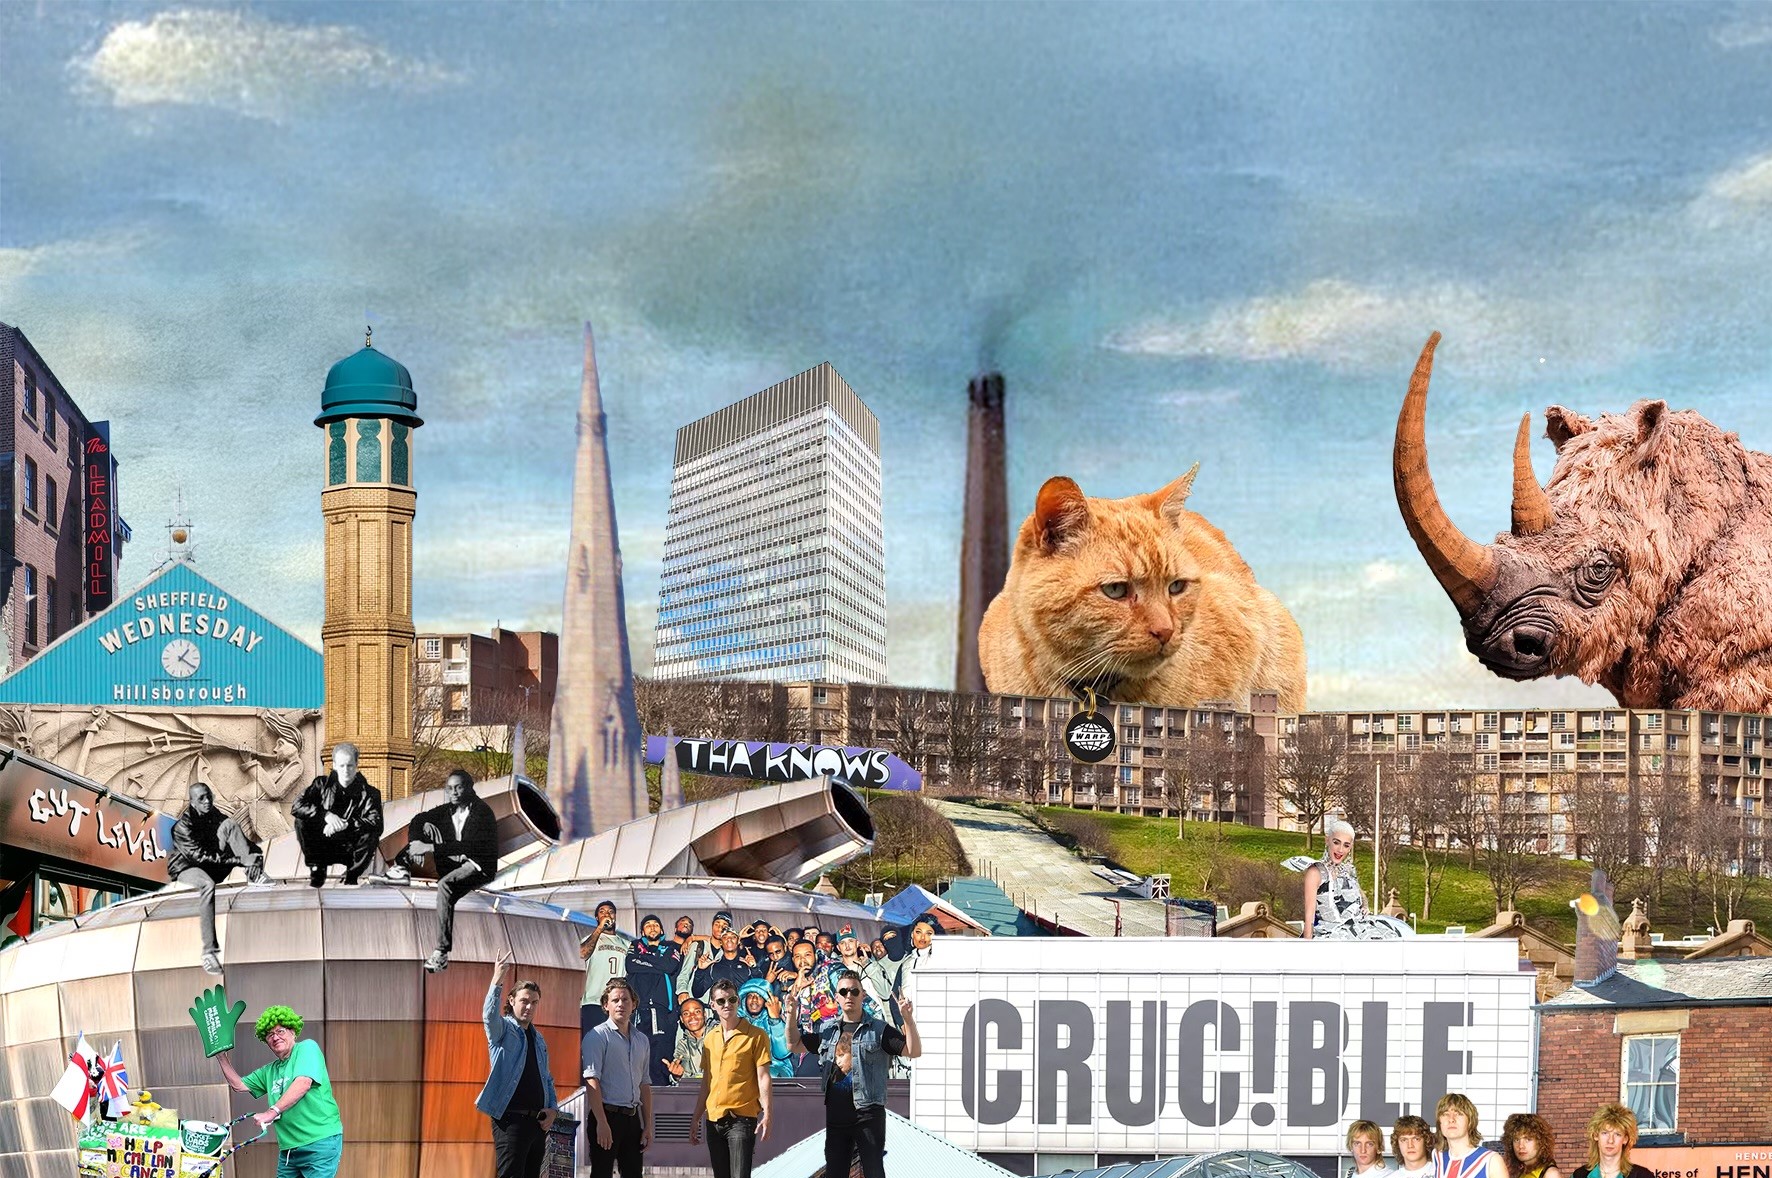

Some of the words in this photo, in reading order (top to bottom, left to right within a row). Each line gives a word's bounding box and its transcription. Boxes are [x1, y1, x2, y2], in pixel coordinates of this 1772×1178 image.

[87, 437, 108, 454] The
[88, 464, 111, 595] LEADMILL
[135, 591, 229, 612] SHEFFIELD
[98, 612, 263, 655] WEDNESDAY
[113, 684, 247, 703] Hillsborough
[682, 740, 753, 776] THA
[765, 744, 890, 783] KNOWS
[29, 788, 91, 837] GUT
[96, 810, 167, 862] LEVEL
[608, 956, 618, 975] 1
[125, 1137, 163, 1154] HELP
[107, 1148, 174, 1169] MACMILLAN
[1652, 1168, 1681, 1178] kers
[1686, 1168, 1699, 1178] of
